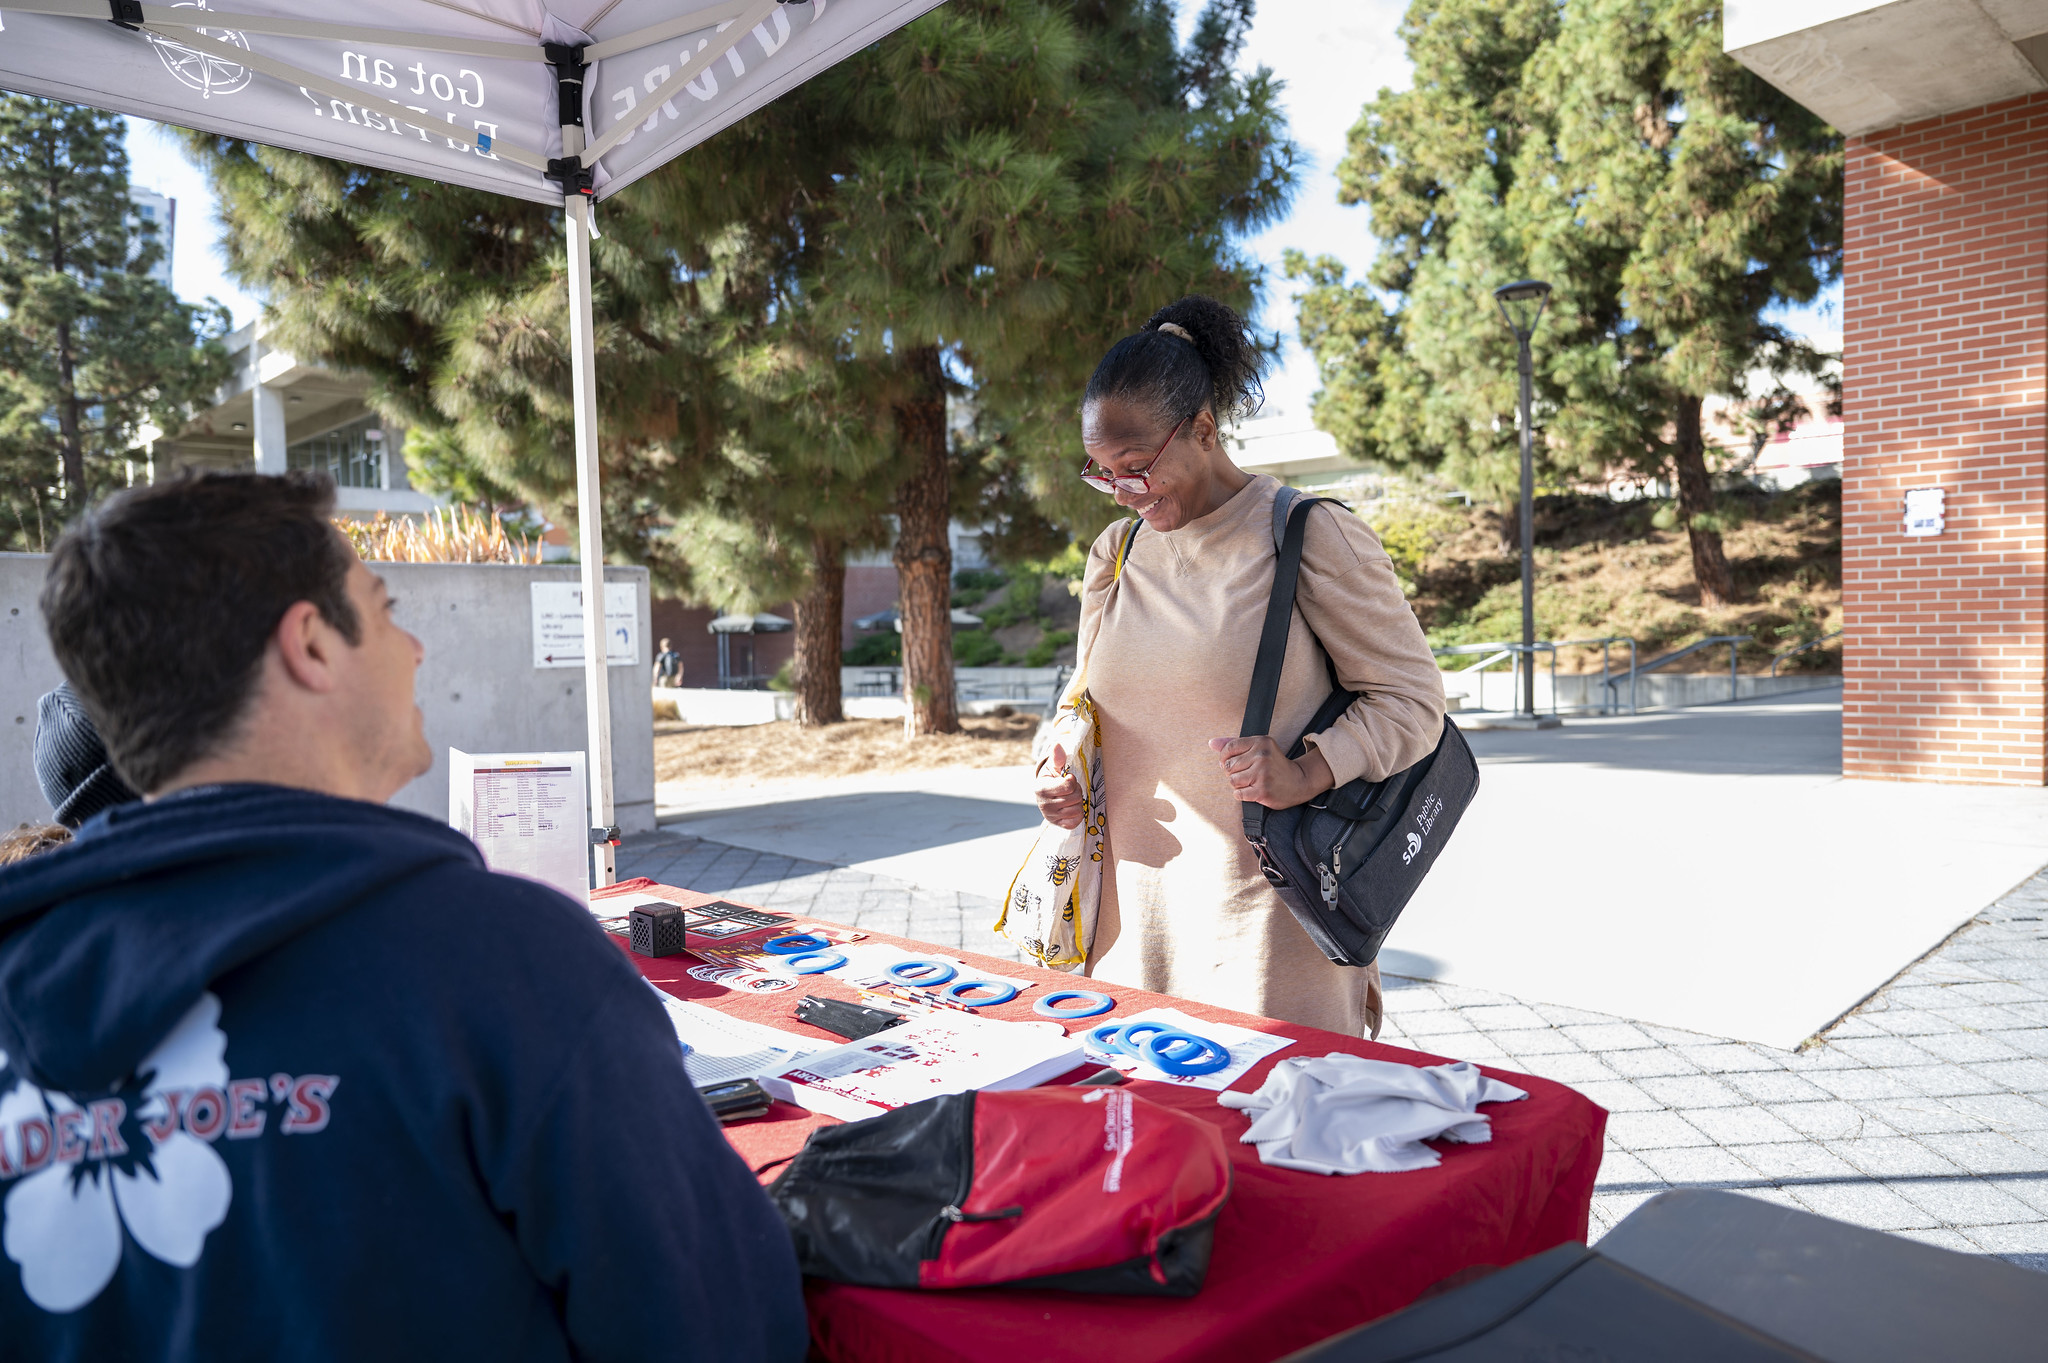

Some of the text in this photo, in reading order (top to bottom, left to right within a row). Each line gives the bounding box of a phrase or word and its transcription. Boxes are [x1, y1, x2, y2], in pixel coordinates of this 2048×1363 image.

[1416, 793, 1436, 827] Public
[1421, 798, 1443, 836] Library
[141, 1072, 340, 1143] JOE'S
